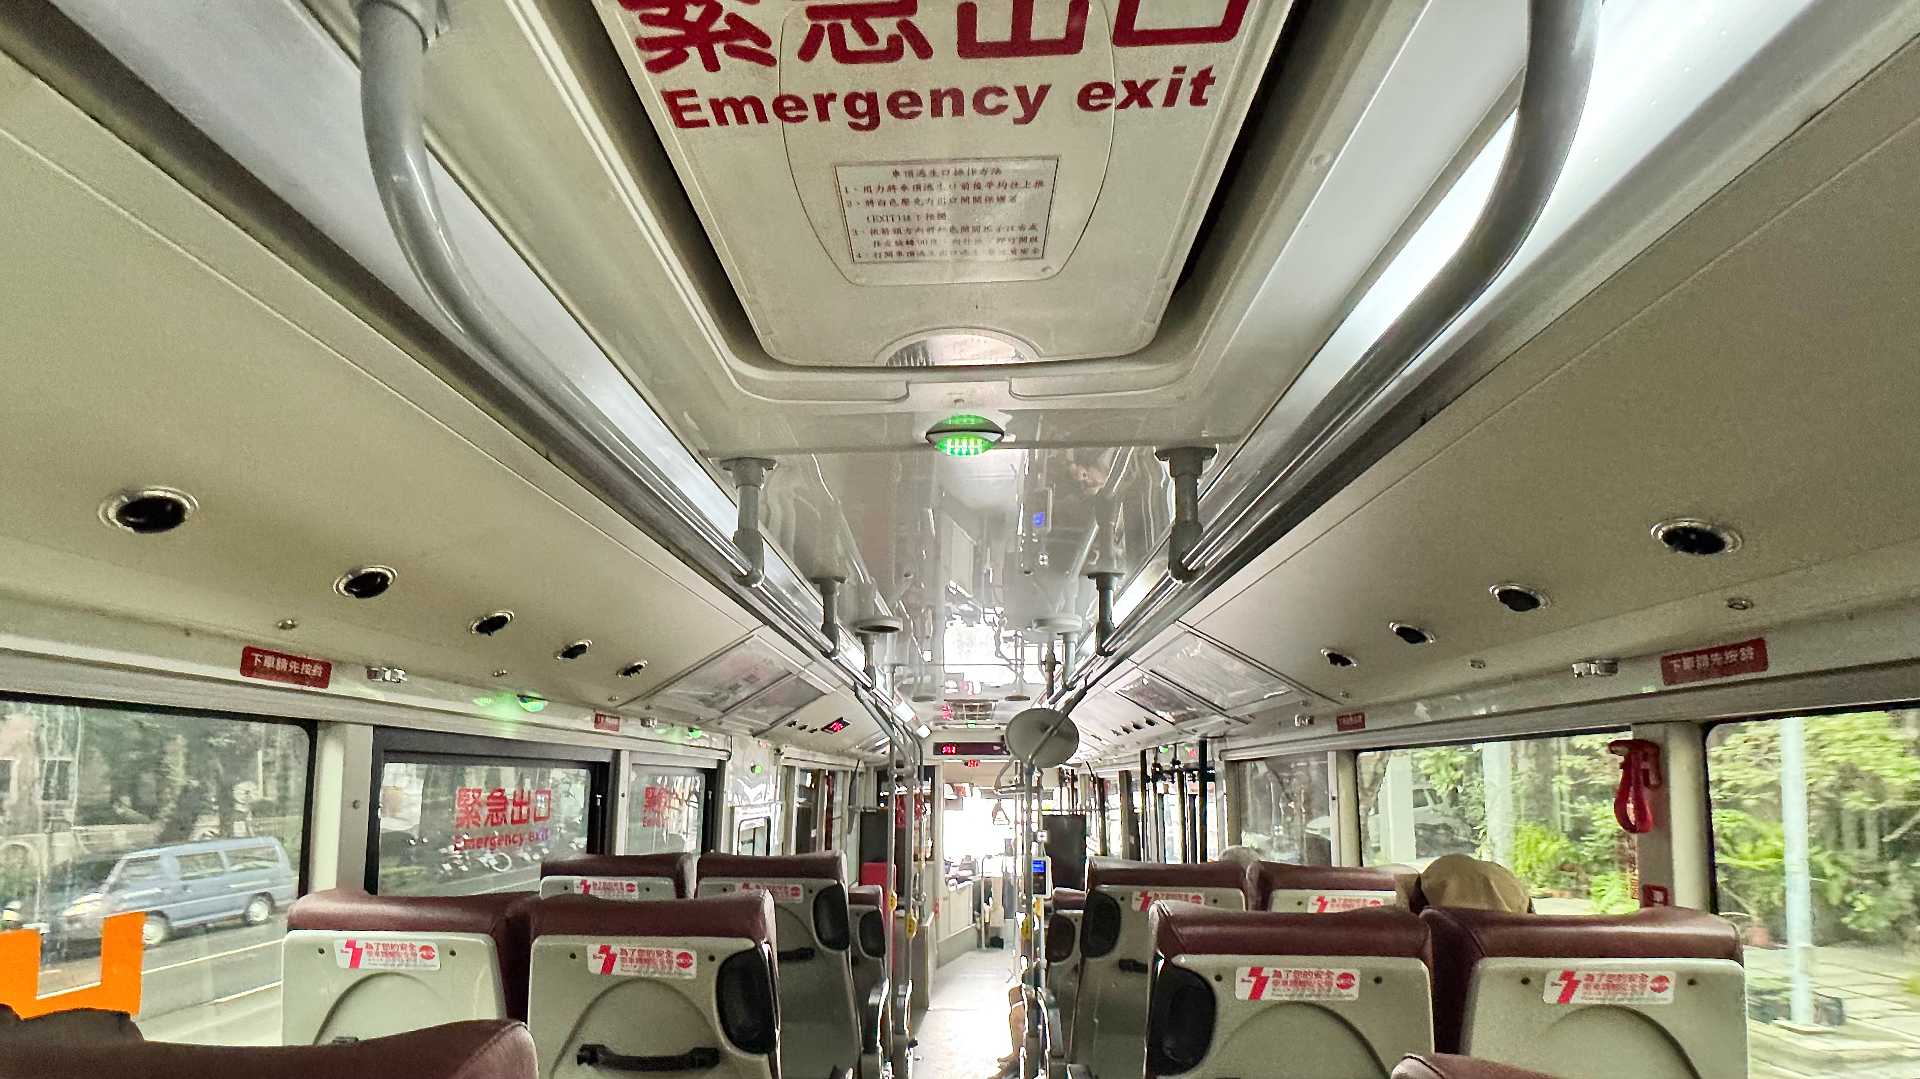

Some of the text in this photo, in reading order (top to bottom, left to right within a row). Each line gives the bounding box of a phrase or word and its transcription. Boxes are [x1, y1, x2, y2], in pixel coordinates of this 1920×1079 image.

[661, 64, 1216, 132] Emergency exit
[251, 653, 323, 677] 下車請先按鈴
[456, 786, 552, 828] 緊急出口
